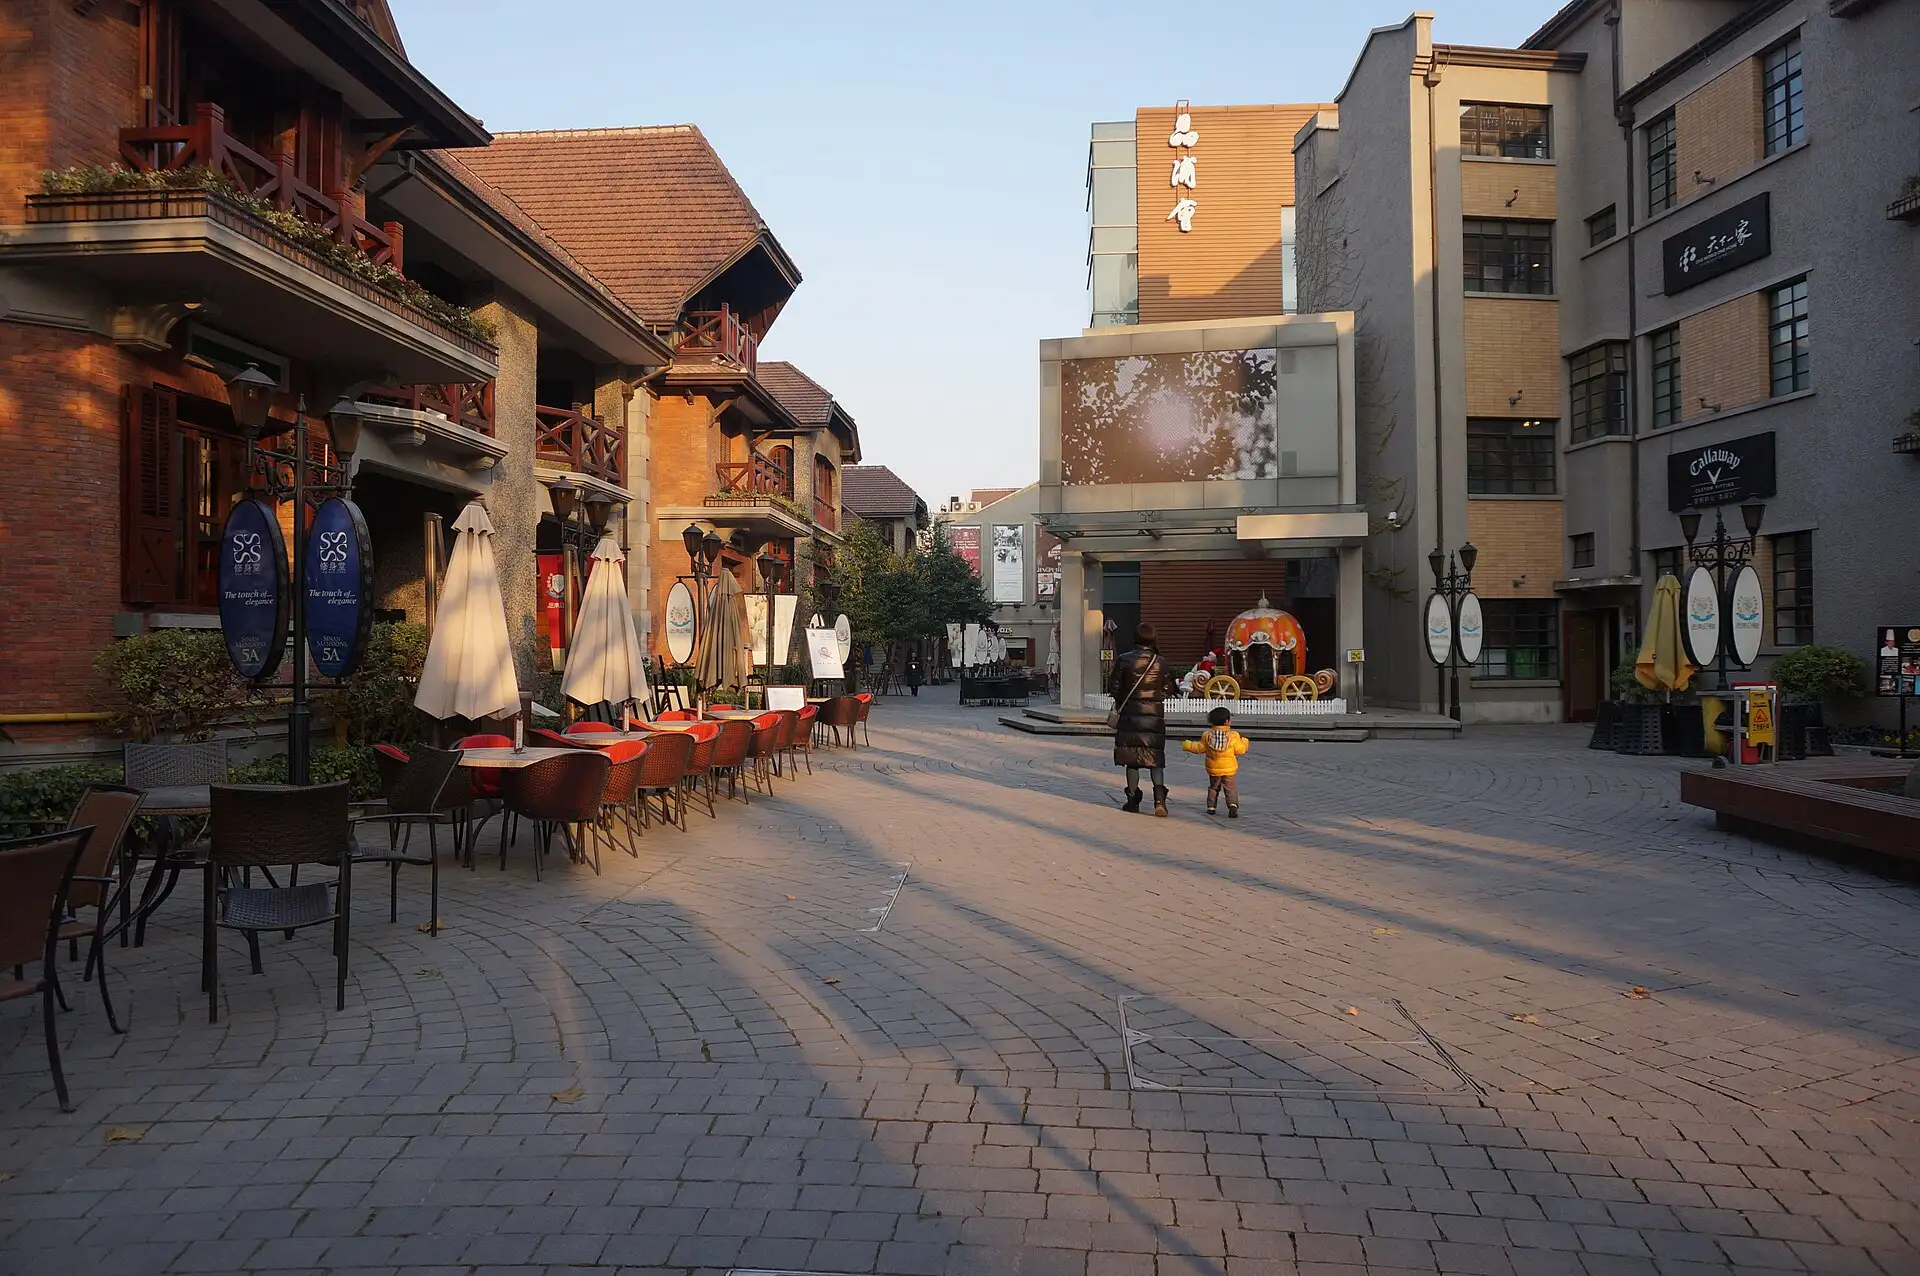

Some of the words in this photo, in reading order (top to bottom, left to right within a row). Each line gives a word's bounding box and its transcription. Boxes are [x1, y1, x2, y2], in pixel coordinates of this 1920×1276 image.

[1690, 449, 1740, 476] Callaway
[320, 562, 346, 571] 修身堂
[224, 591, 237, 599] The
[237, 589, 259, 599] touch
[308, 589, 321, 597] The
[321, 588, 343, 597] touch
[245, 598, 274, 606] elegance
[327, 597, 357, 605] elegance
[241, 648, 260, 662] 5A
[322, 647, 341, 662] 5A
